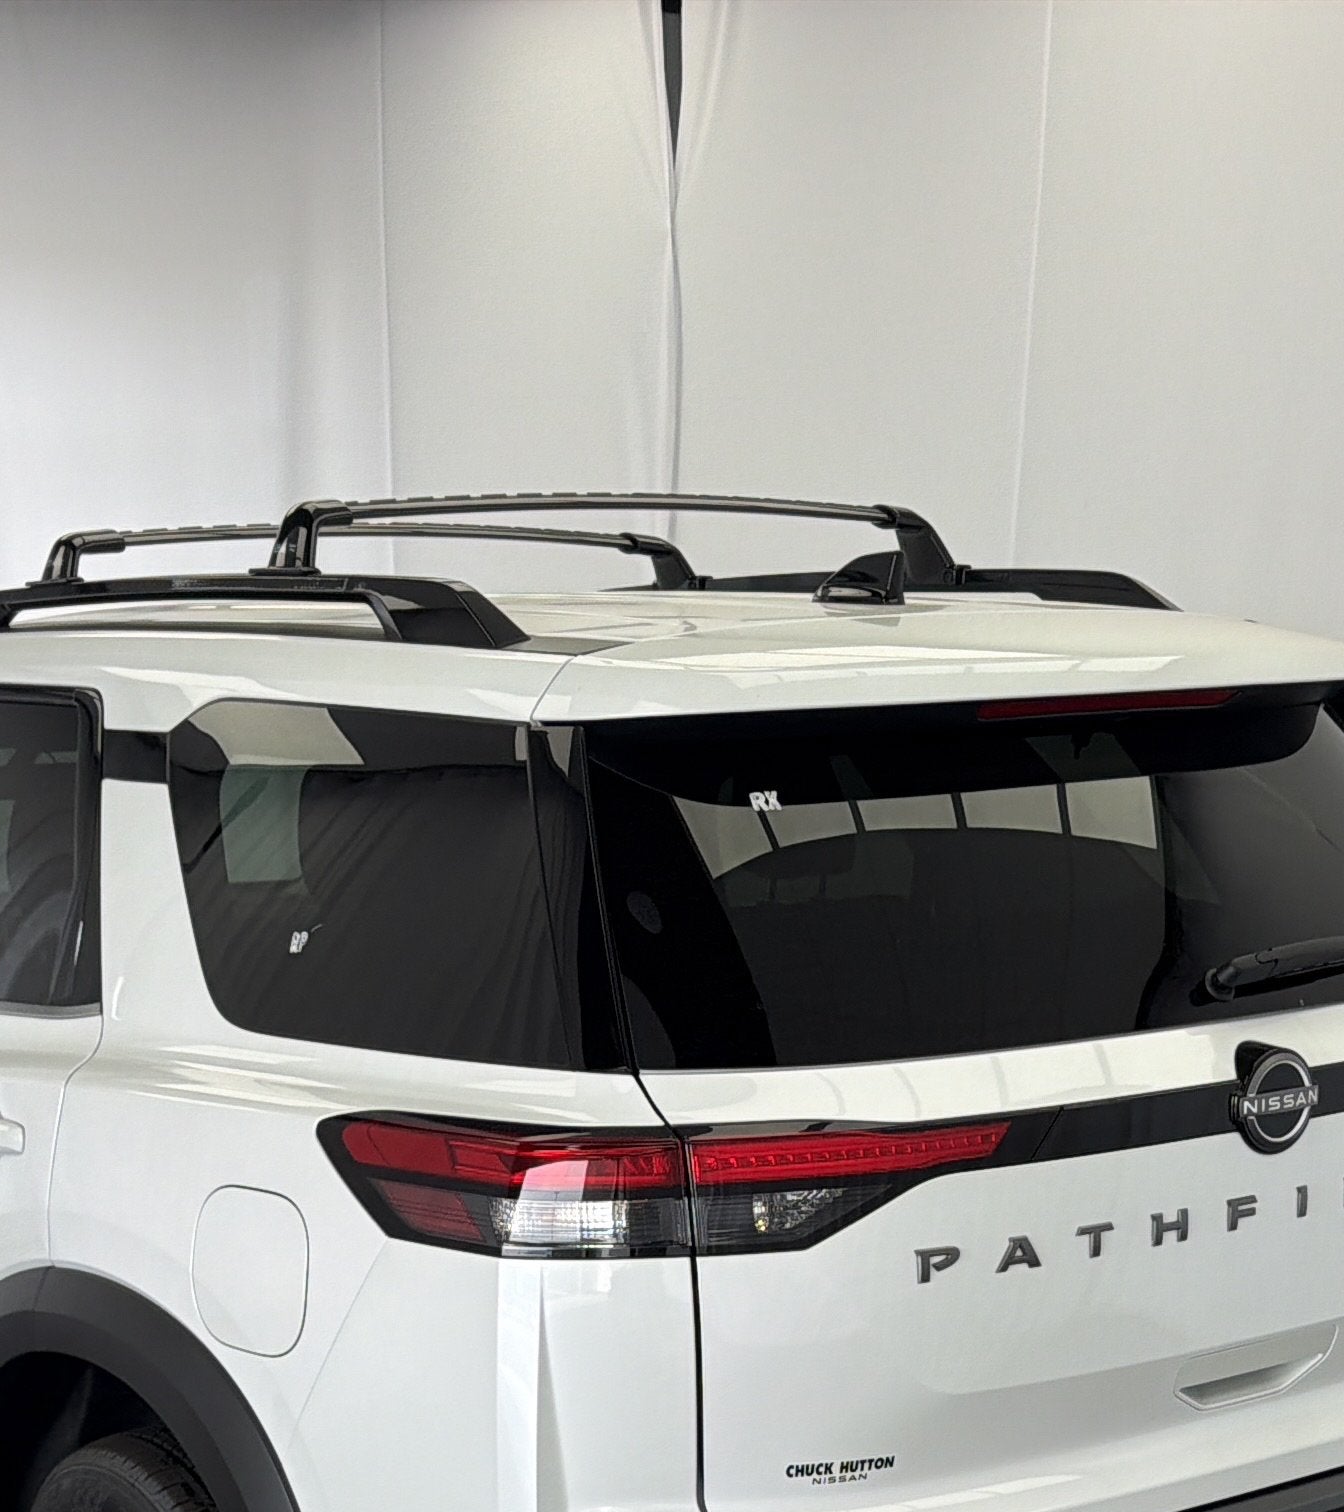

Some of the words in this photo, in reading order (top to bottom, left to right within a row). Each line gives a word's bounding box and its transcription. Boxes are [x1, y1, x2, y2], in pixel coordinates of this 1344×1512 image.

[1243, 1088, 1318, 1115] NISSAN
[785, 1462, 834, 1478] CHUCK
[839, 1455, 896, 1475] HUTTON
[812, 1473, 868, 1486] NISSAN
